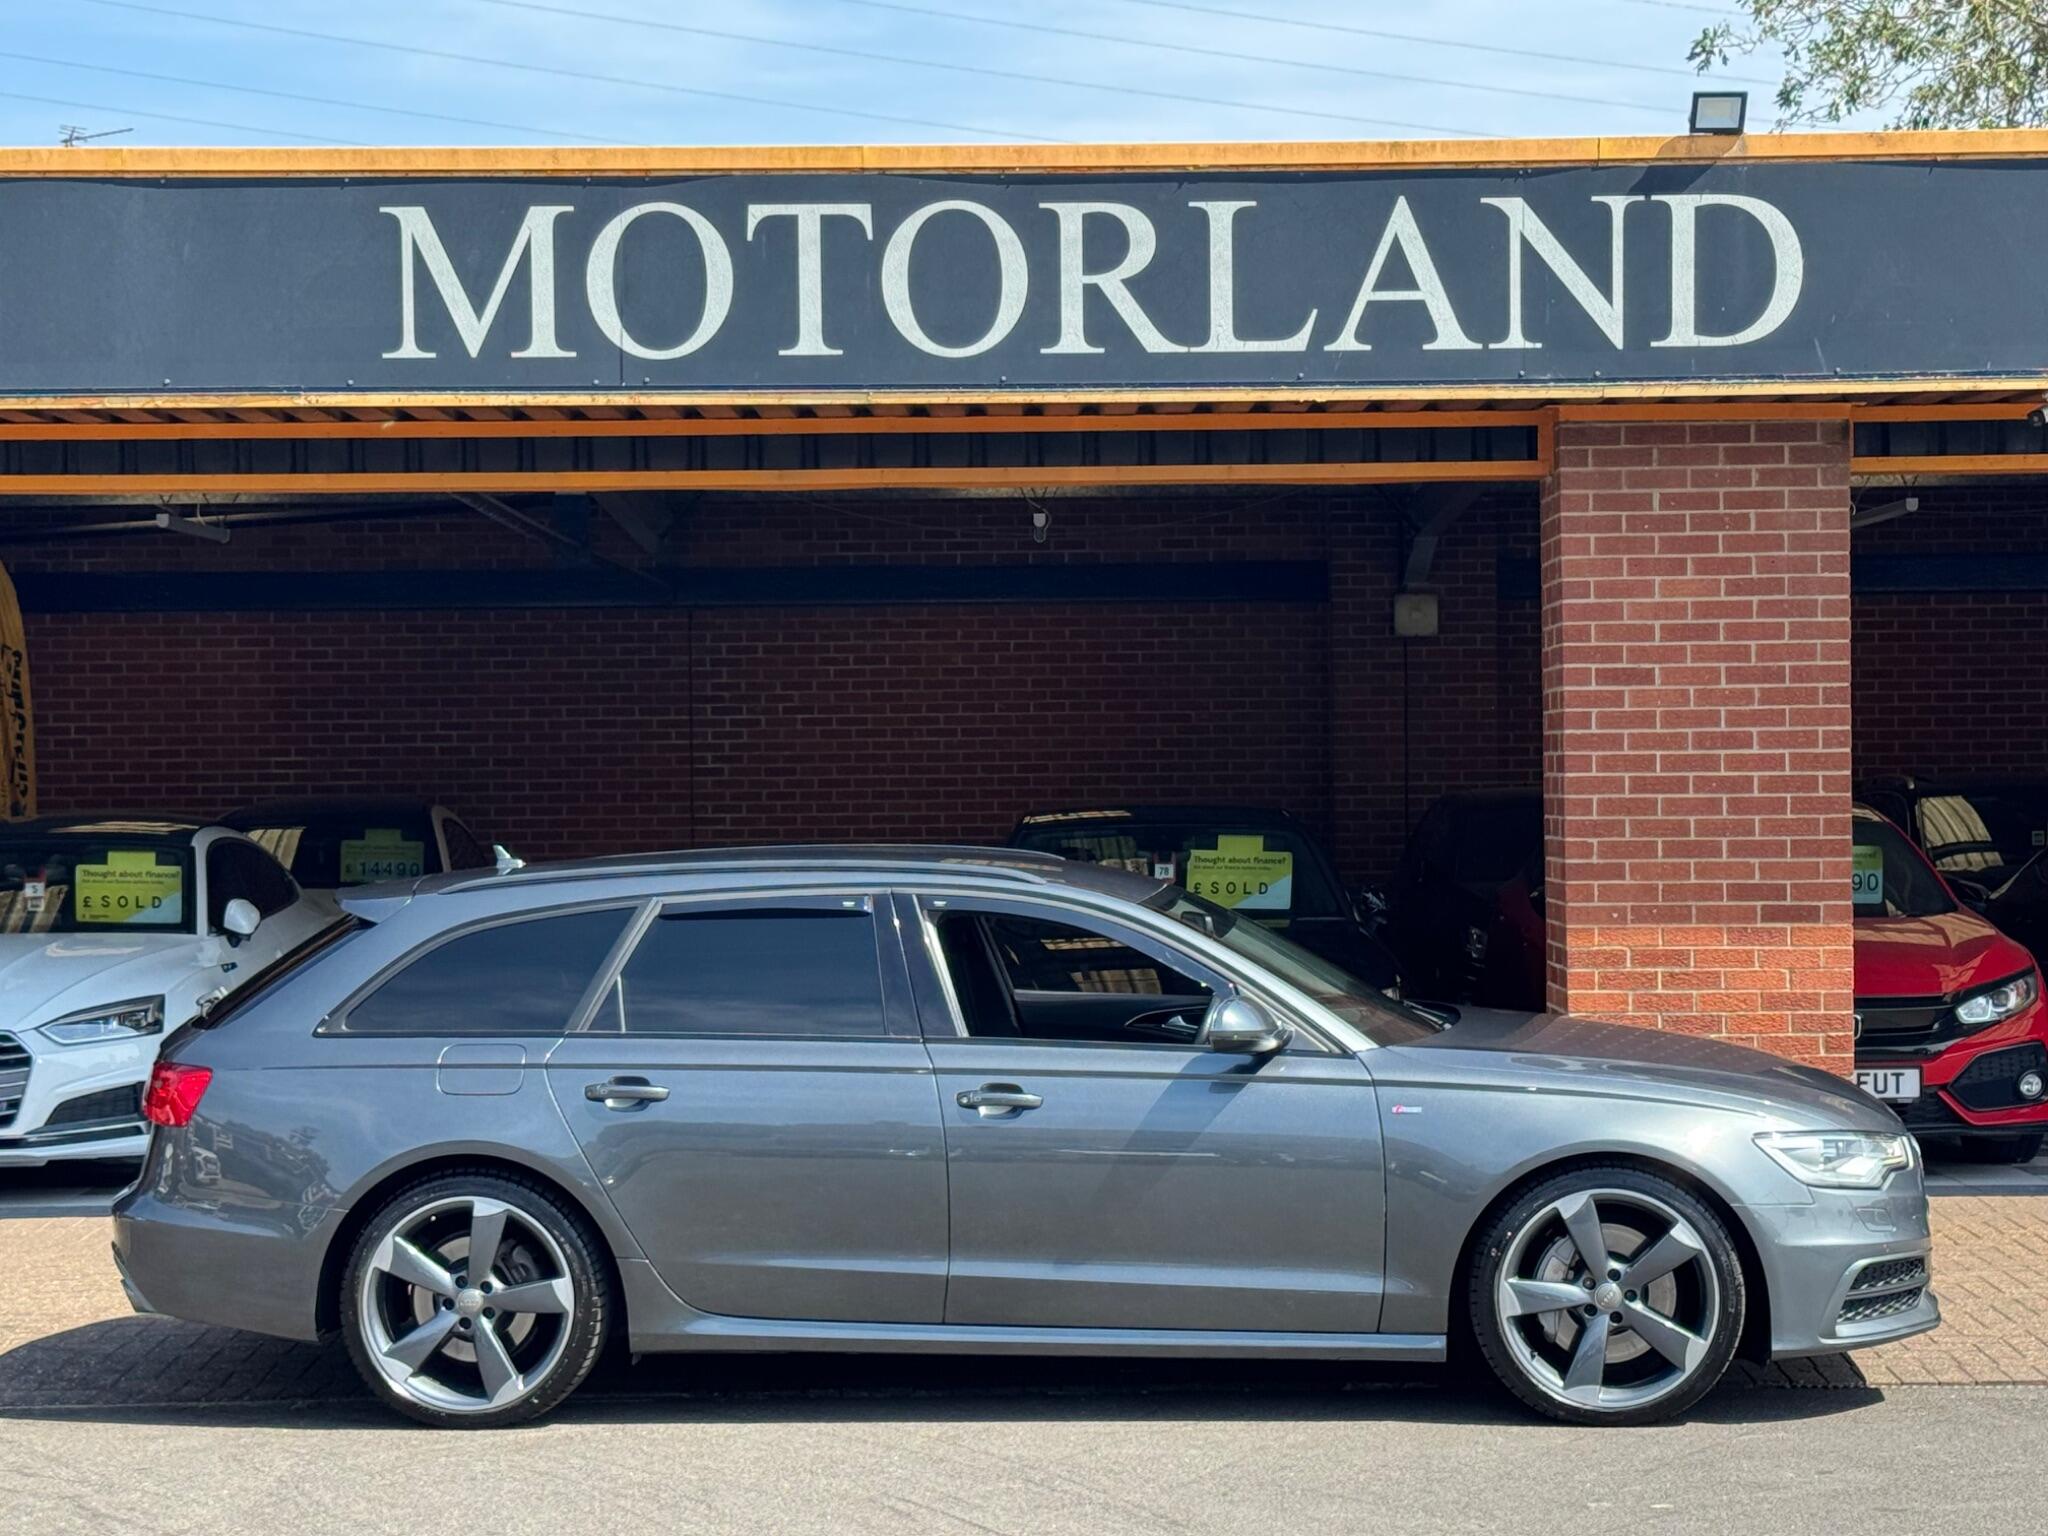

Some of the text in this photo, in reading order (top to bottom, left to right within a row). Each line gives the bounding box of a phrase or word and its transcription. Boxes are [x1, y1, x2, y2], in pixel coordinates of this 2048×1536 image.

[378, 194, 1804, 361] MOTORLAND
[1193, 855, 1287, 865] Thought about finance?
[81, 869, 117, 879] Thought
[118, 869, 144, 879] about
[359, 861, 420, 877] 14490
[1159, 866, 1170, 876] 78
[1210, 881, 1269, 895] SOLD
[100, 895, 163, 909] SOLD
[1856, 1072, 1906, 1095] FUT
